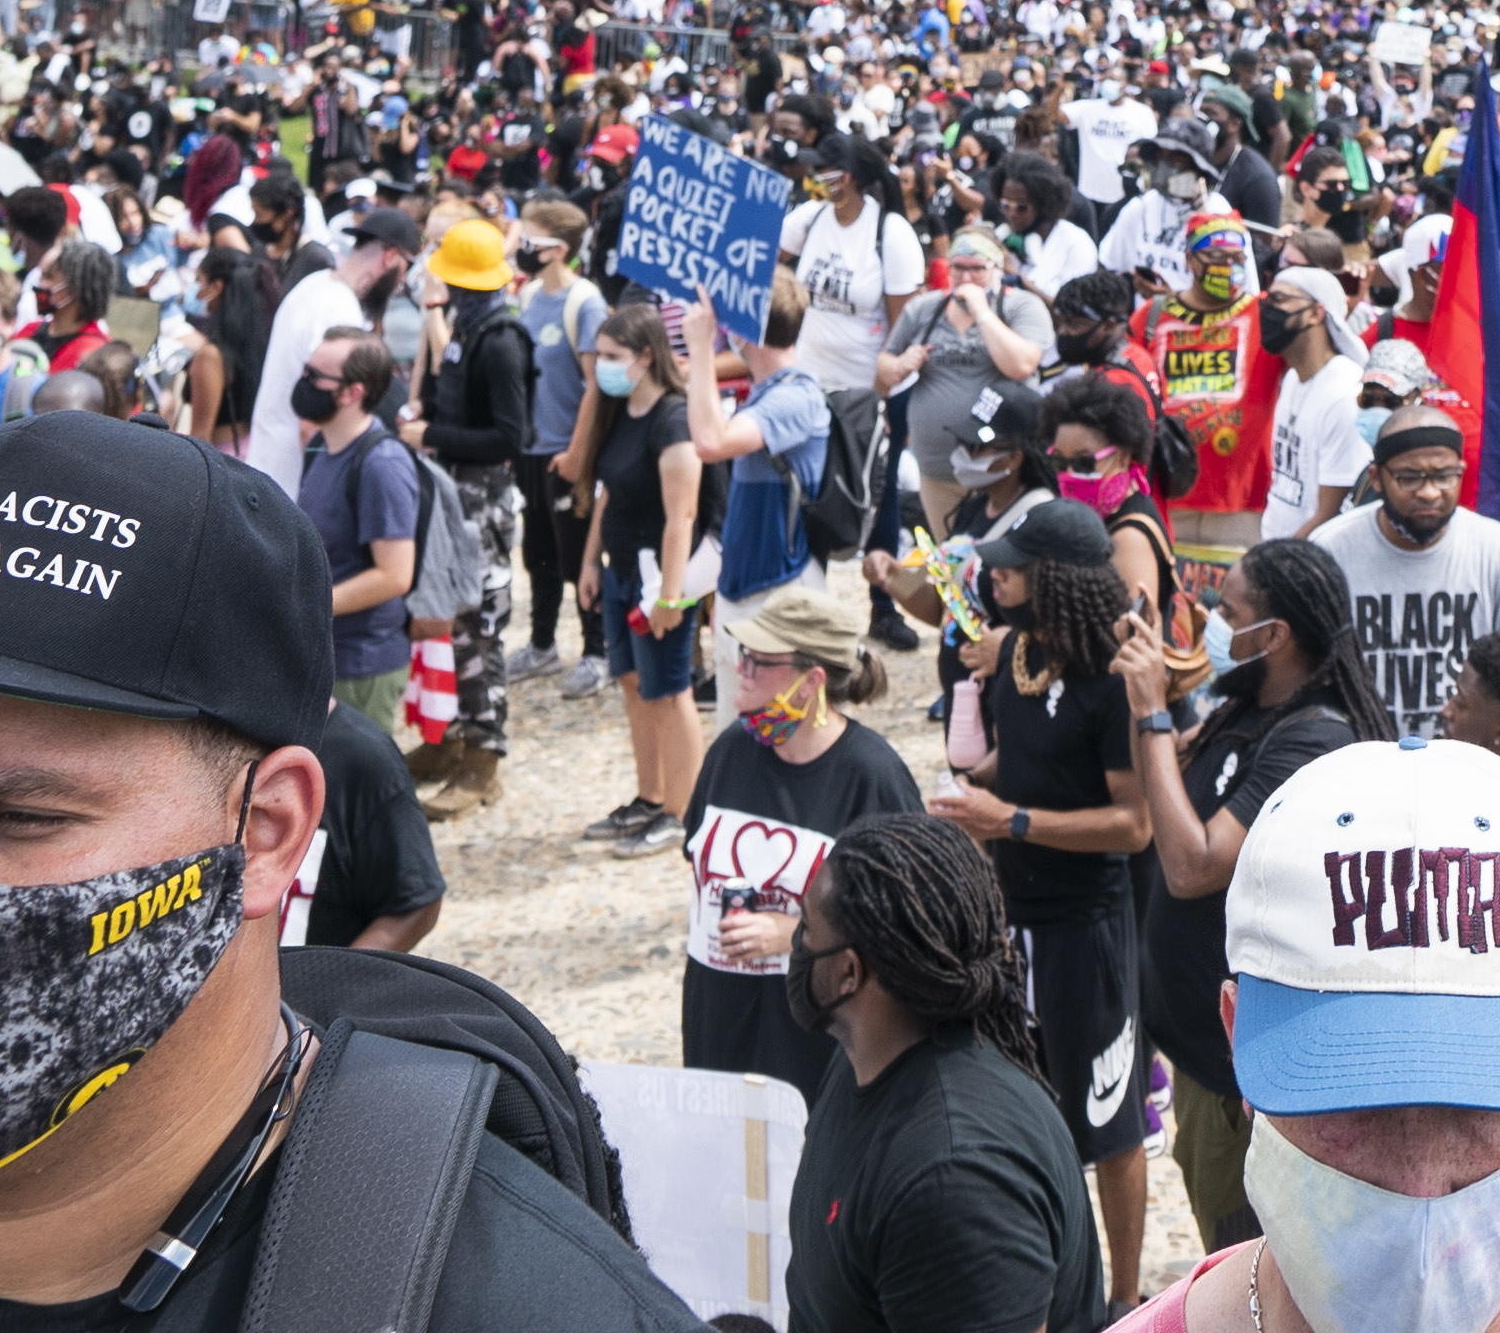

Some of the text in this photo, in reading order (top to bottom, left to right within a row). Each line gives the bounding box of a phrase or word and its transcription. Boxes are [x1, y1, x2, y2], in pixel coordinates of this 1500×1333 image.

[631, 155, 737, 225] A QUIET
[641, 115, 796, 209] WE ARE NOT
[628, 186, 770, 278] POCKET OF
[1168, 351, 1232, 375] LIVES
[1356, 592, 1479, 653] BLACK
